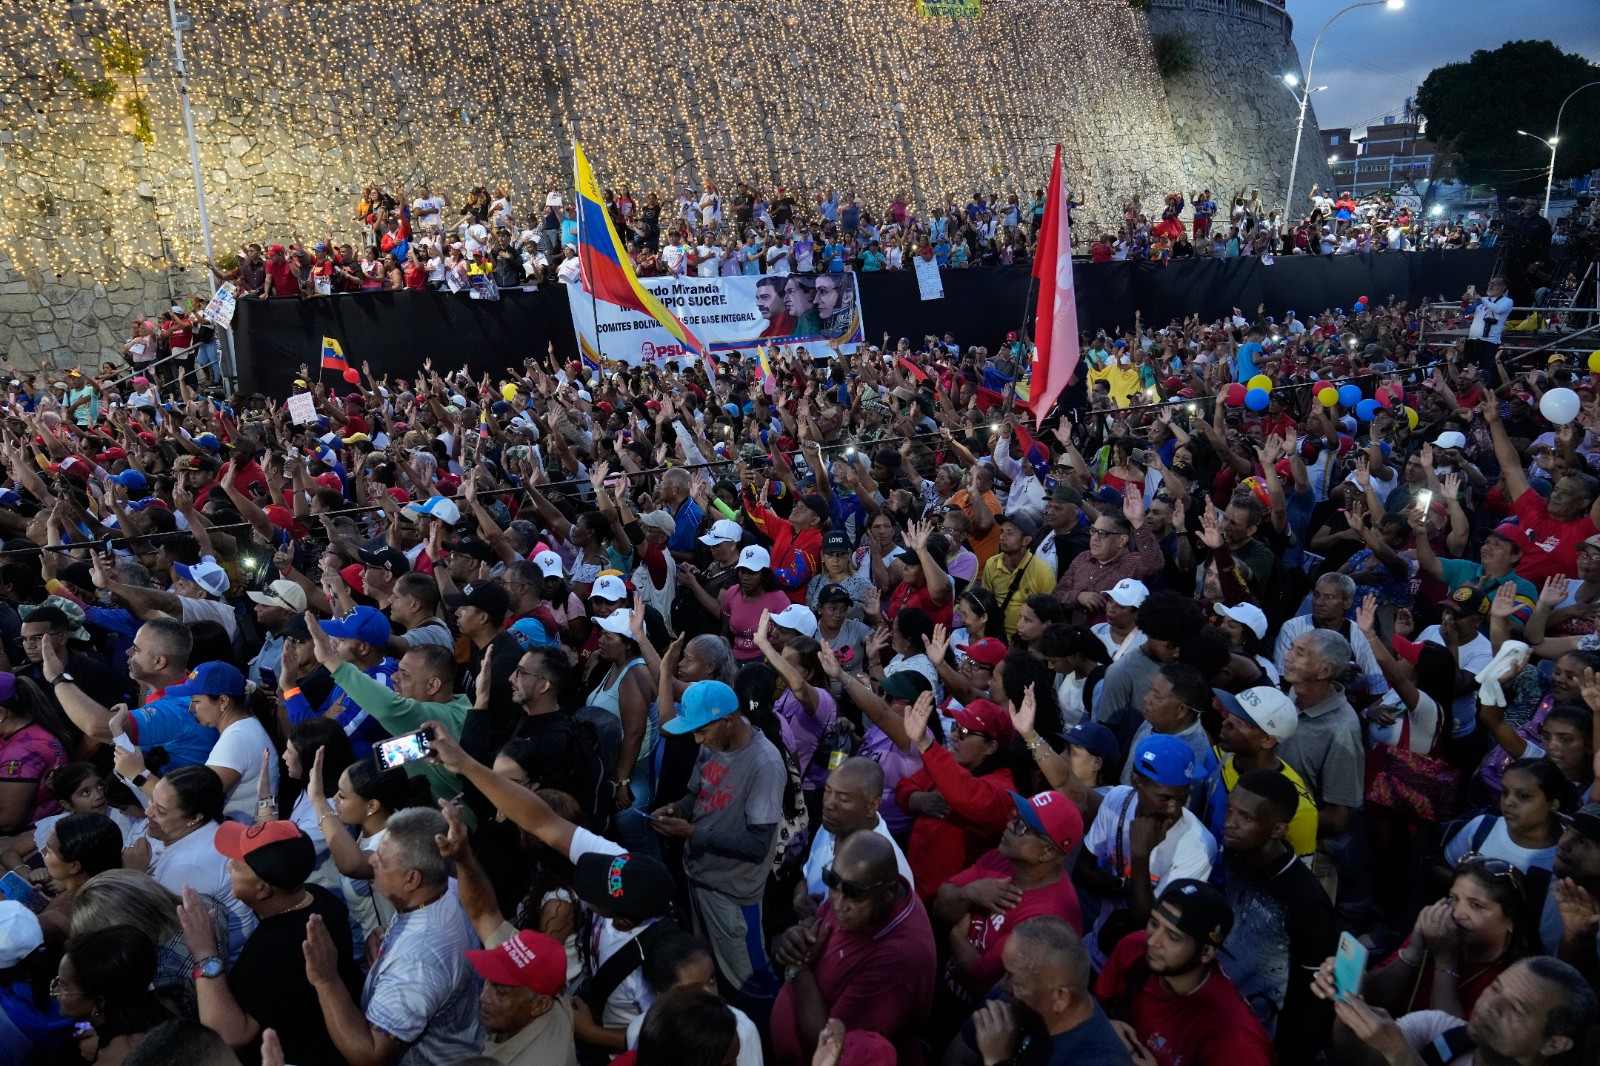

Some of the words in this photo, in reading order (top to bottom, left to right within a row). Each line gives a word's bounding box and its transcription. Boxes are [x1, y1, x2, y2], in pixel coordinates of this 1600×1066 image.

[672, 284, 719, 295] Miranda
[688, 295, 727, 307] SUCRE
[597, 321, 631, 333] COMITES
[690, 316, 700, 324] DE
[701, 315, 719, 324] BASE
[721, 313, 756, 323] INTEGRAL
[656, 345, 687, 358] PSU
